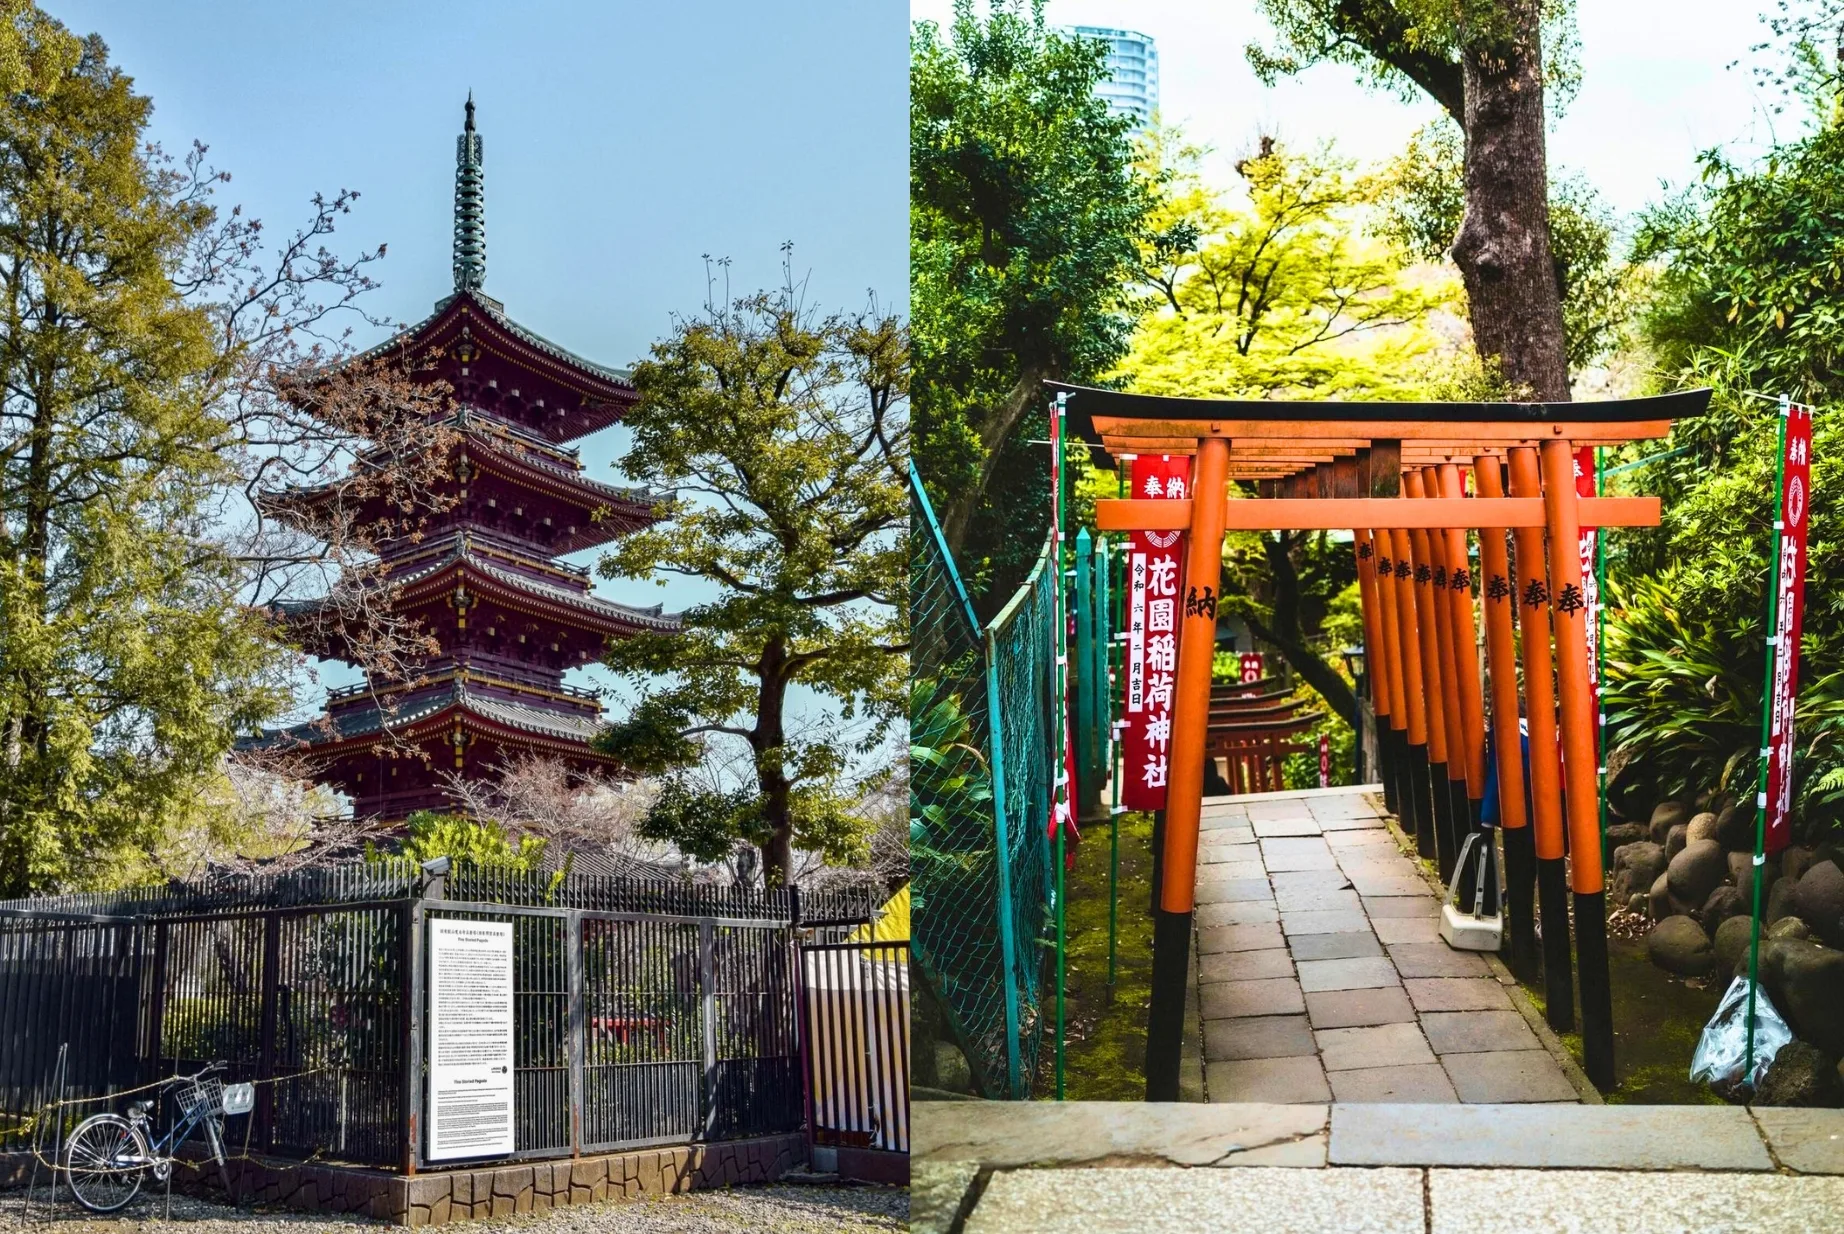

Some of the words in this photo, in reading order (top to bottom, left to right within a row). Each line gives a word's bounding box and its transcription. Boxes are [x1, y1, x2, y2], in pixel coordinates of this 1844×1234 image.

[1143, 474, 1185, 499] 奉納
[1358, 542, 1372, 561] 奉
[1378, 557, 1393, 577] 奉
[1394, 560, 1412, 581] 奉
[1415, 563, 1432, 585] 奉
[1434, 565, 1447, 590] 奉
[1450, 568, 1470, 594] 奉
[1487, 574, 1509, 603] 奉
[1185, 585, 1217, 622] 納
[1523, 578, 1547, 611] 奉
[1557, 583, 1584, 618] 奉
[1131, 563, 1145, 705] 令和六年二月吉日
[1142, 553, 1178, 789] 花園稲荷神社
